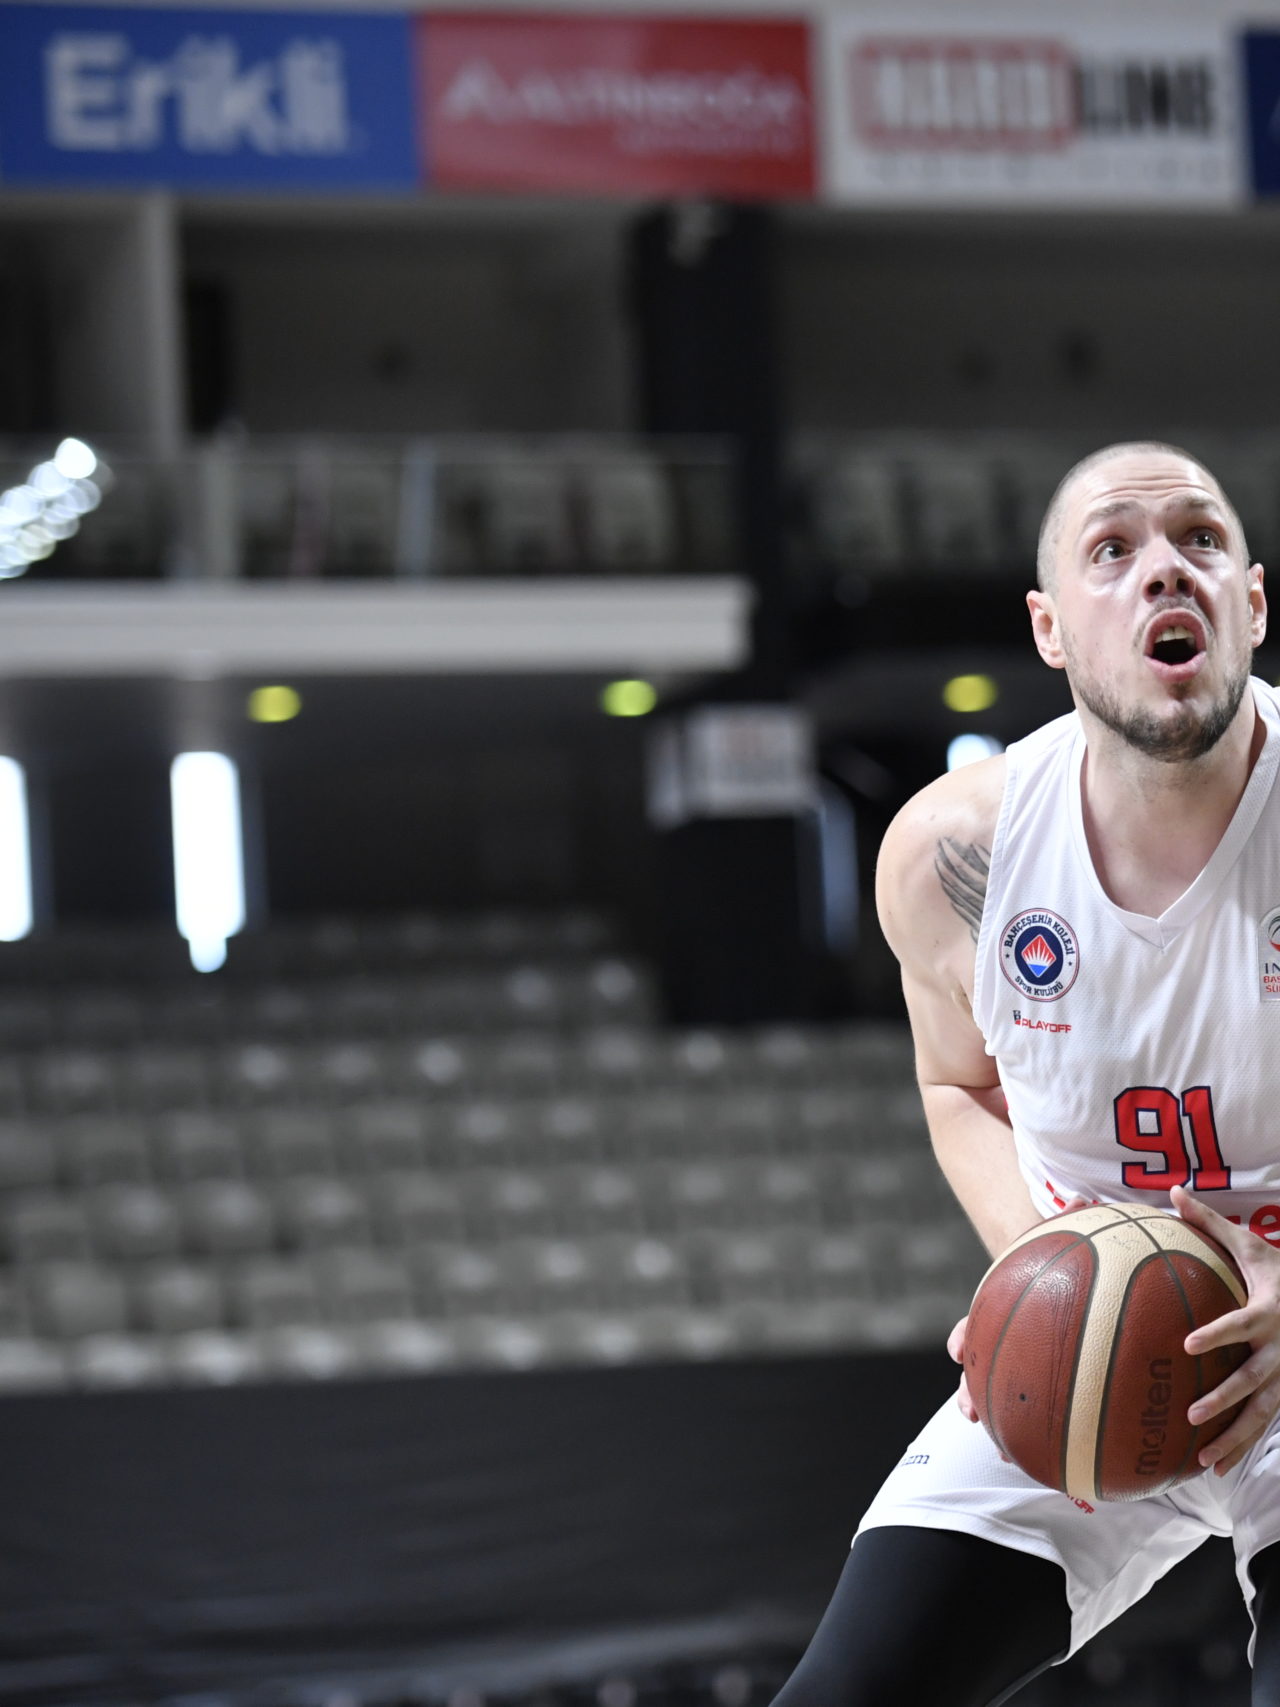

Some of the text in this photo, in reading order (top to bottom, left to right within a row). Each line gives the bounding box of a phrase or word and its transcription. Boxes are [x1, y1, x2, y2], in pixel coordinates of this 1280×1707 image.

[46, 32, 348, 154] Erikli
[1004, 914, 1053, 948] BAHÇEŞEHİR
[1021, 1018, 1072, 1034] PLAYOFF
[1113, 1085, 1231, 1192] 91
[1134, 1357, 1173, 1476] molten
